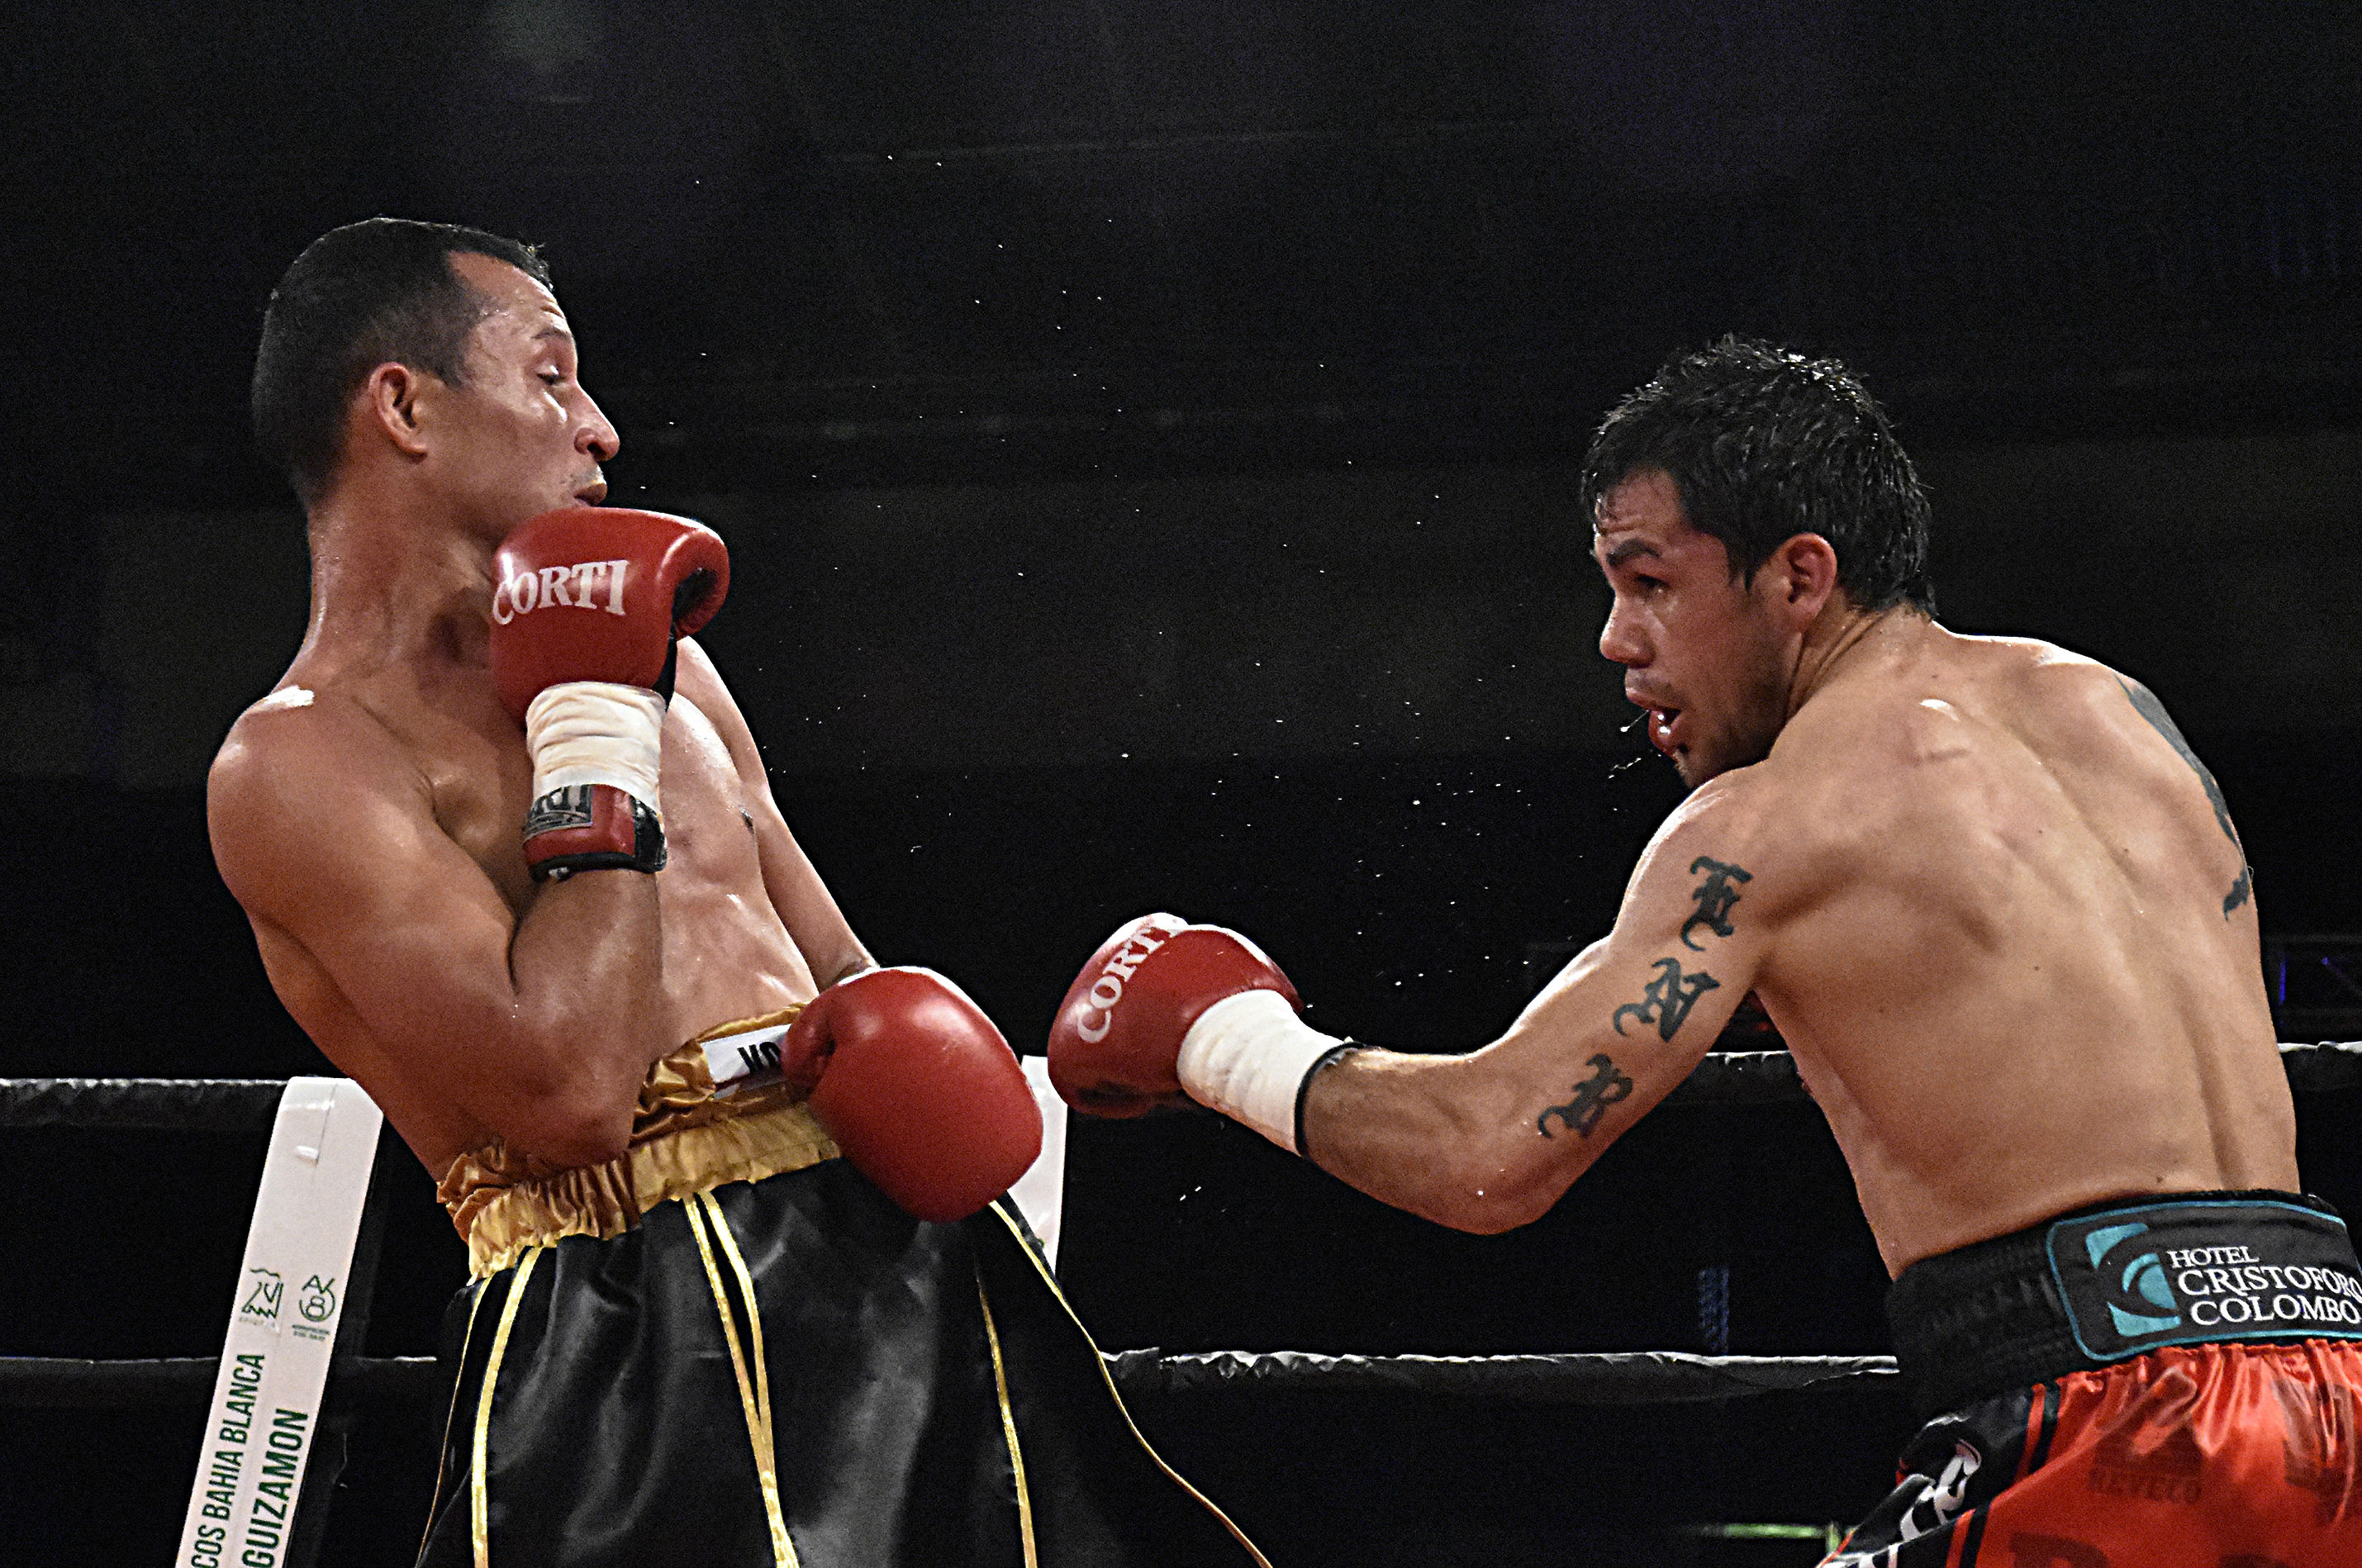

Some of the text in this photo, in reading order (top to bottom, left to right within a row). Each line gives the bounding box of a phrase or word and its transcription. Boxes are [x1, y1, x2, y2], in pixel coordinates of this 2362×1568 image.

[492, 552, 630, 625] CORTI
[2166, 1245, 2260, 1269] HOTEL
[2178, 1266, 2362, 1304] CRISTOFORO
[2190, 1294, 2361, 1326] COLOMBO
[219, 1354, 265, 1445] BLANCA
[202, 1451, 244, 1521] BAHIA
[241, 1408, 309, 1568] GUIZAMON
[191, 1525, 226, 1568] COS
